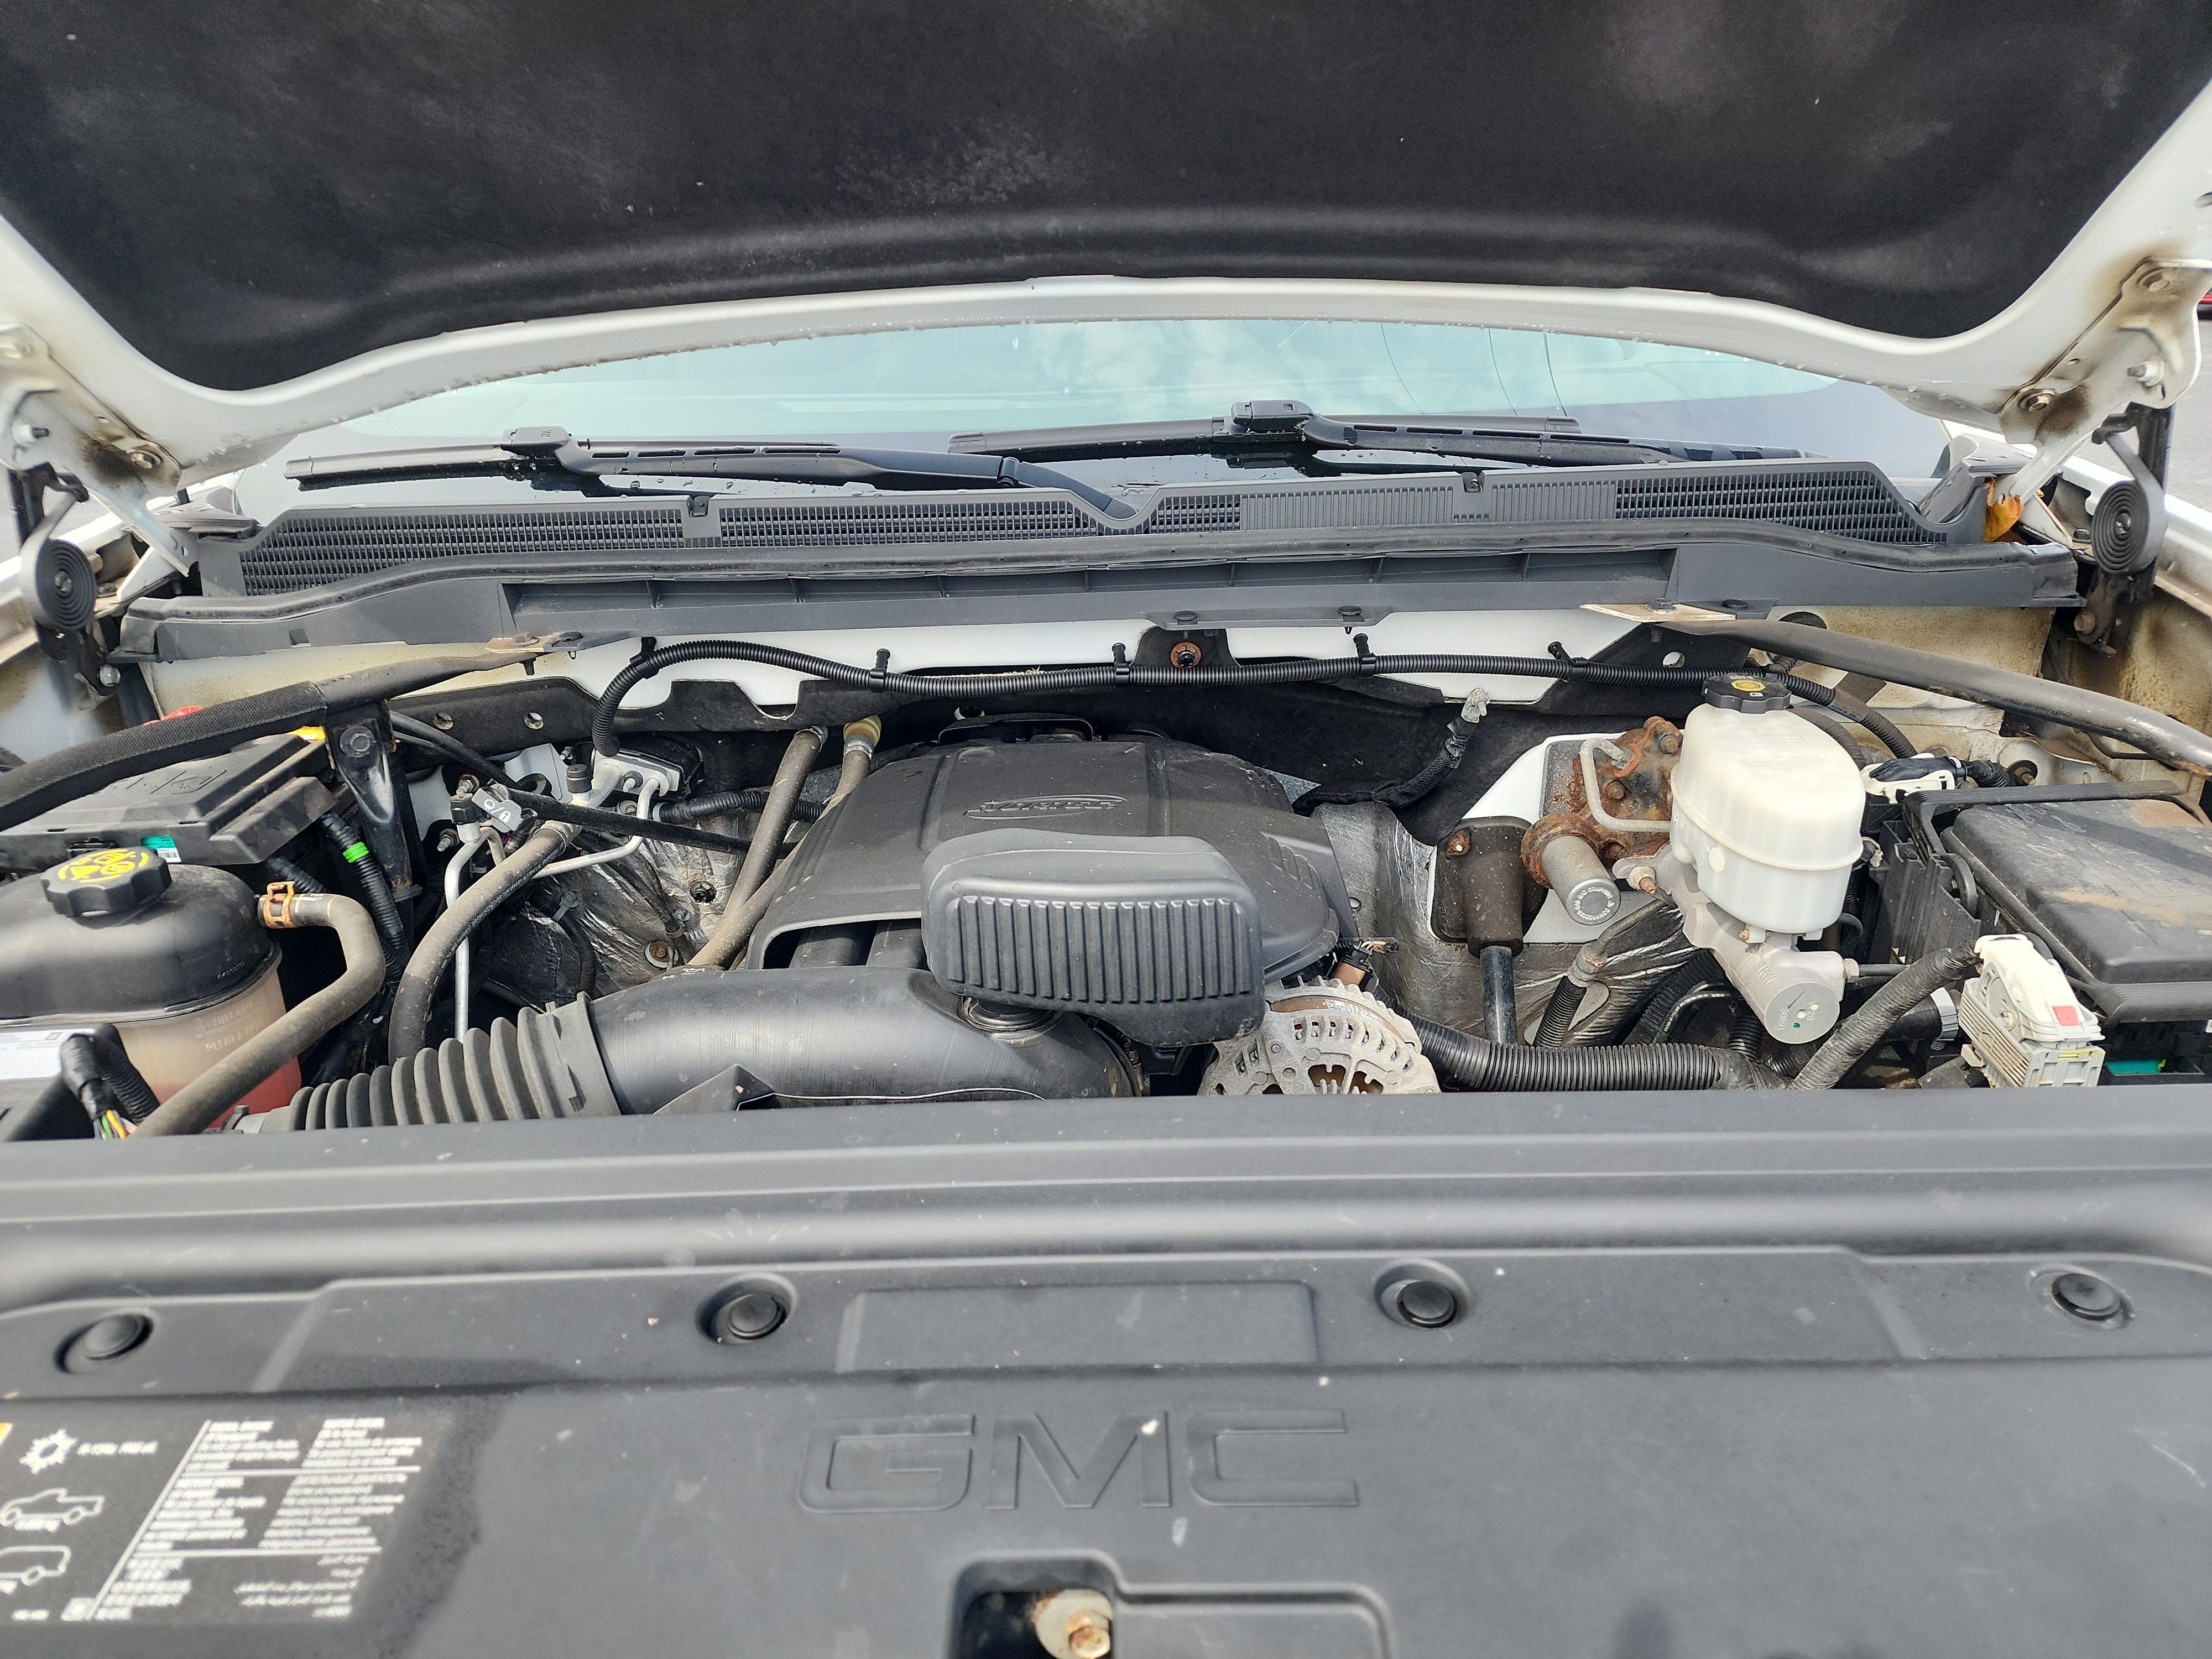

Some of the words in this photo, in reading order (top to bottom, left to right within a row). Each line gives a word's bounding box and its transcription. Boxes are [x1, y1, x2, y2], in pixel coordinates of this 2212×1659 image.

[470, 912, 484, 927] HOSE
[1756, 963, 1778, 985] TRW
[1806, 1001, 1819, 1021] 128
[796, 1408, 1360, 1515] GMC
